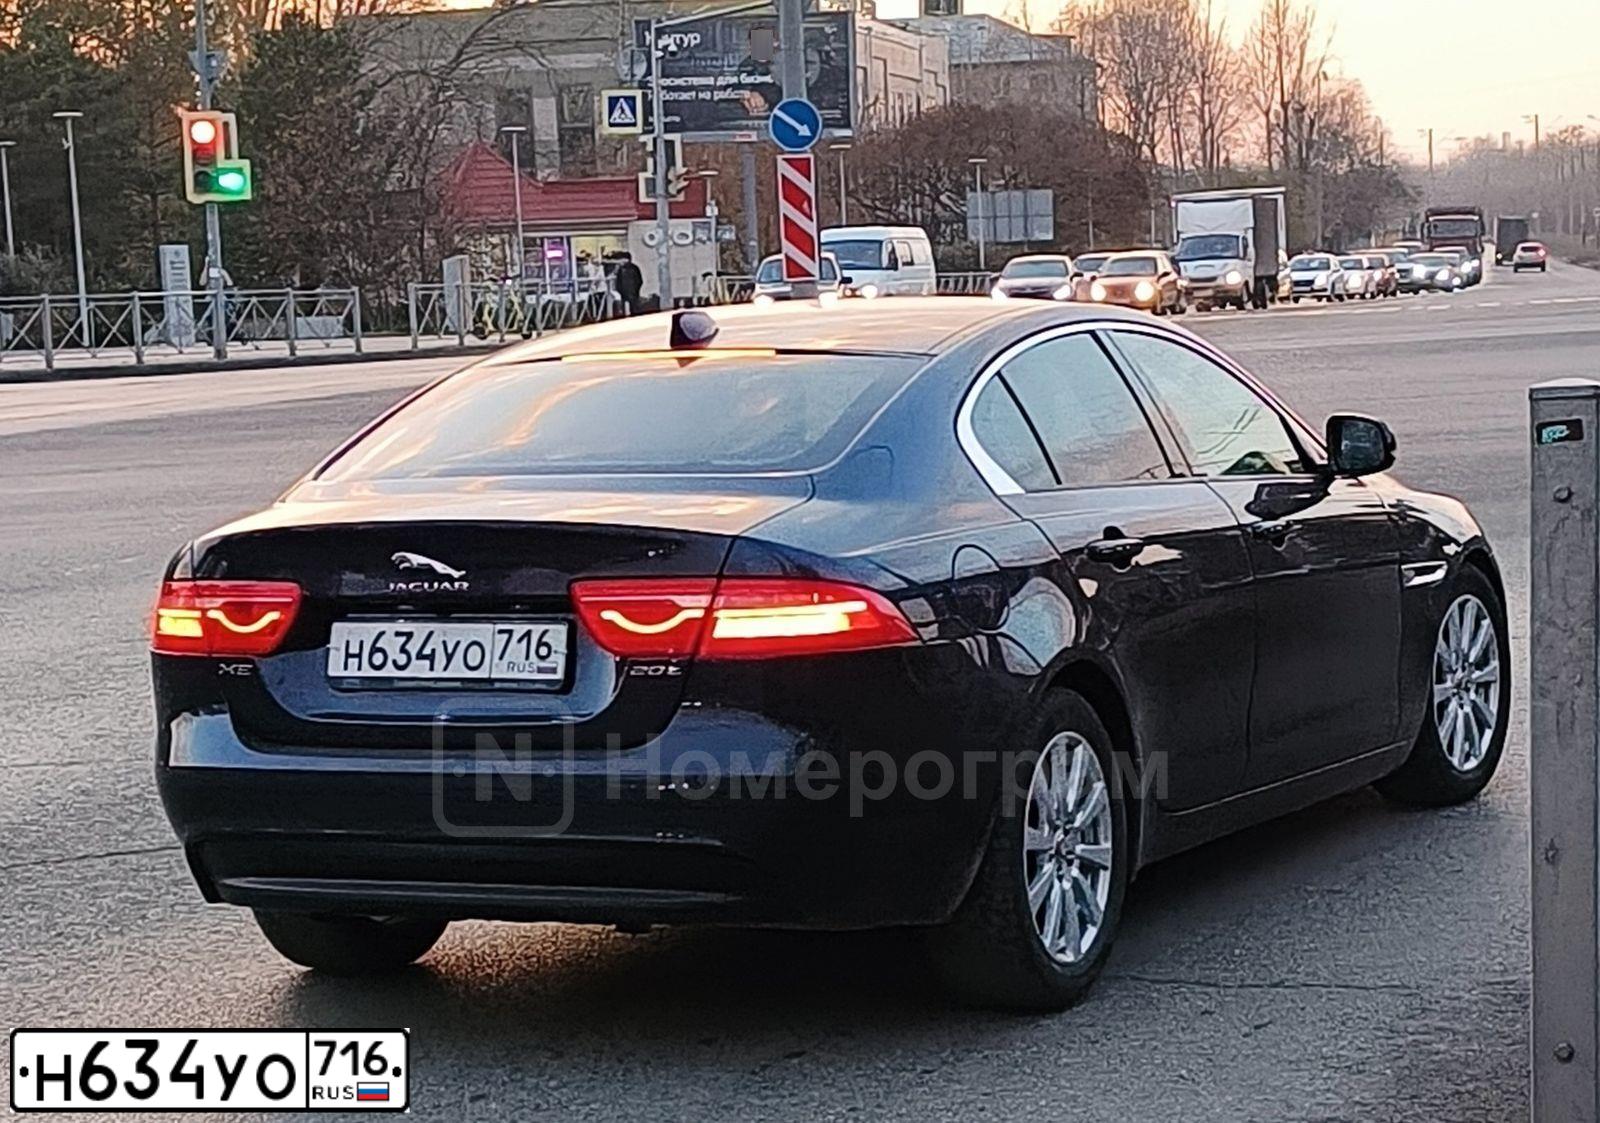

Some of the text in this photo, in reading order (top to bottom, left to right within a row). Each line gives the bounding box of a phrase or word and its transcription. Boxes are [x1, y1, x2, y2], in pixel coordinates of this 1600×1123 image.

[644, 31, 701, 48] Ктур
[388, 581, 470, 594] JAGUAR
[342, 628, 552, 672] Н634УО 716
[218, 663, 253, 676] XE
[507, 661, 536, 674] RUS
